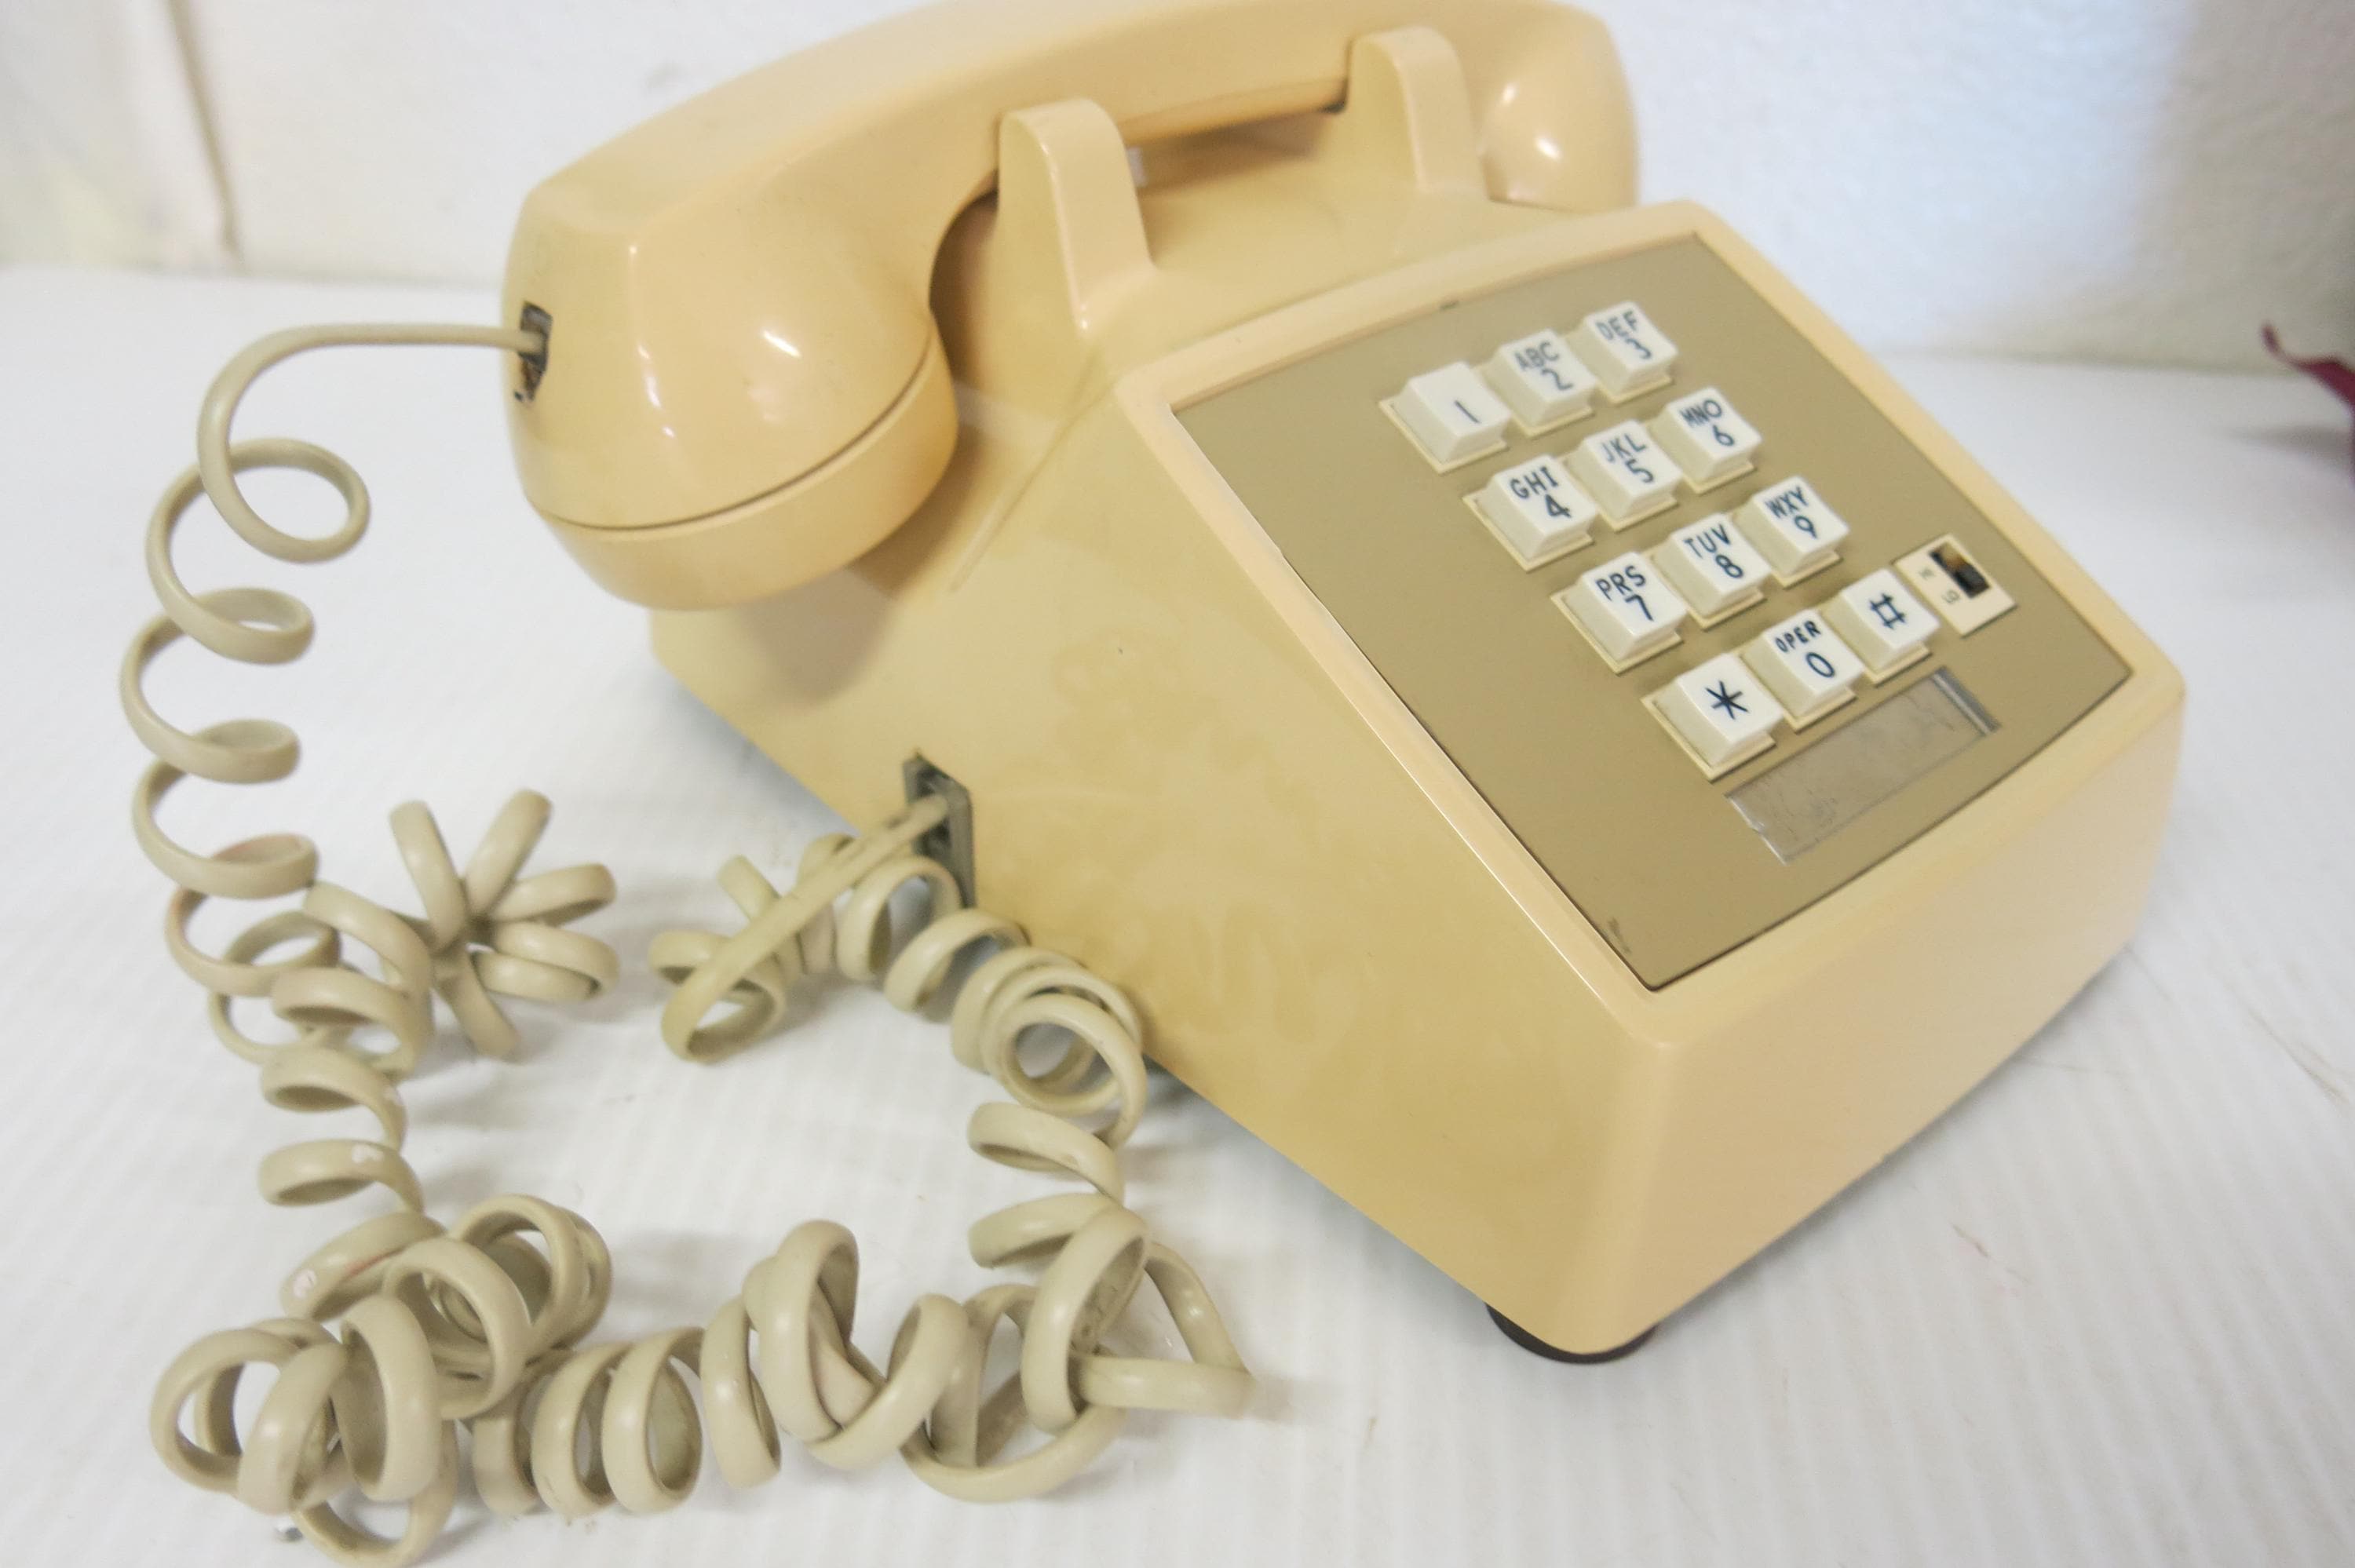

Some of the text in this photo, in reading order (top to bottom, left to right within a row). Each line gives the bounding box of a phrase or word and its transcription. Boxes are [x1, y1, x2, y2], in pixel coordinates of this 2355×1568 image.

[1597, 309, 1638, 341] DEF
[1515, 342, 1559, 370] ABC
[1625, 337, 1652, 360] 3
[1541, 368, 1574, 391] 2
[1679, 399, 1723, 428] MNO
[1601, 432, 1646, 464] JKL
[1713, 425, 1735, 447] 6
[1510, 465, 1559, 499] GHI
[1624, 458, 1654, 484] 5
[1544, 494, 1571, 519] 4
[1765, 487, 1809, 518] WXY
[1684, 525, 1732, 558] TUV
[1795, 516, 1817, 538] 9
[1715, 553, 1743, 578] 8
[1595, 565, 1648, 600] PRS
[1625, 593, 1656, 622] 7
[1868, 593, 1907, 629] #
[1776, 621, 1821, 653] OPER
